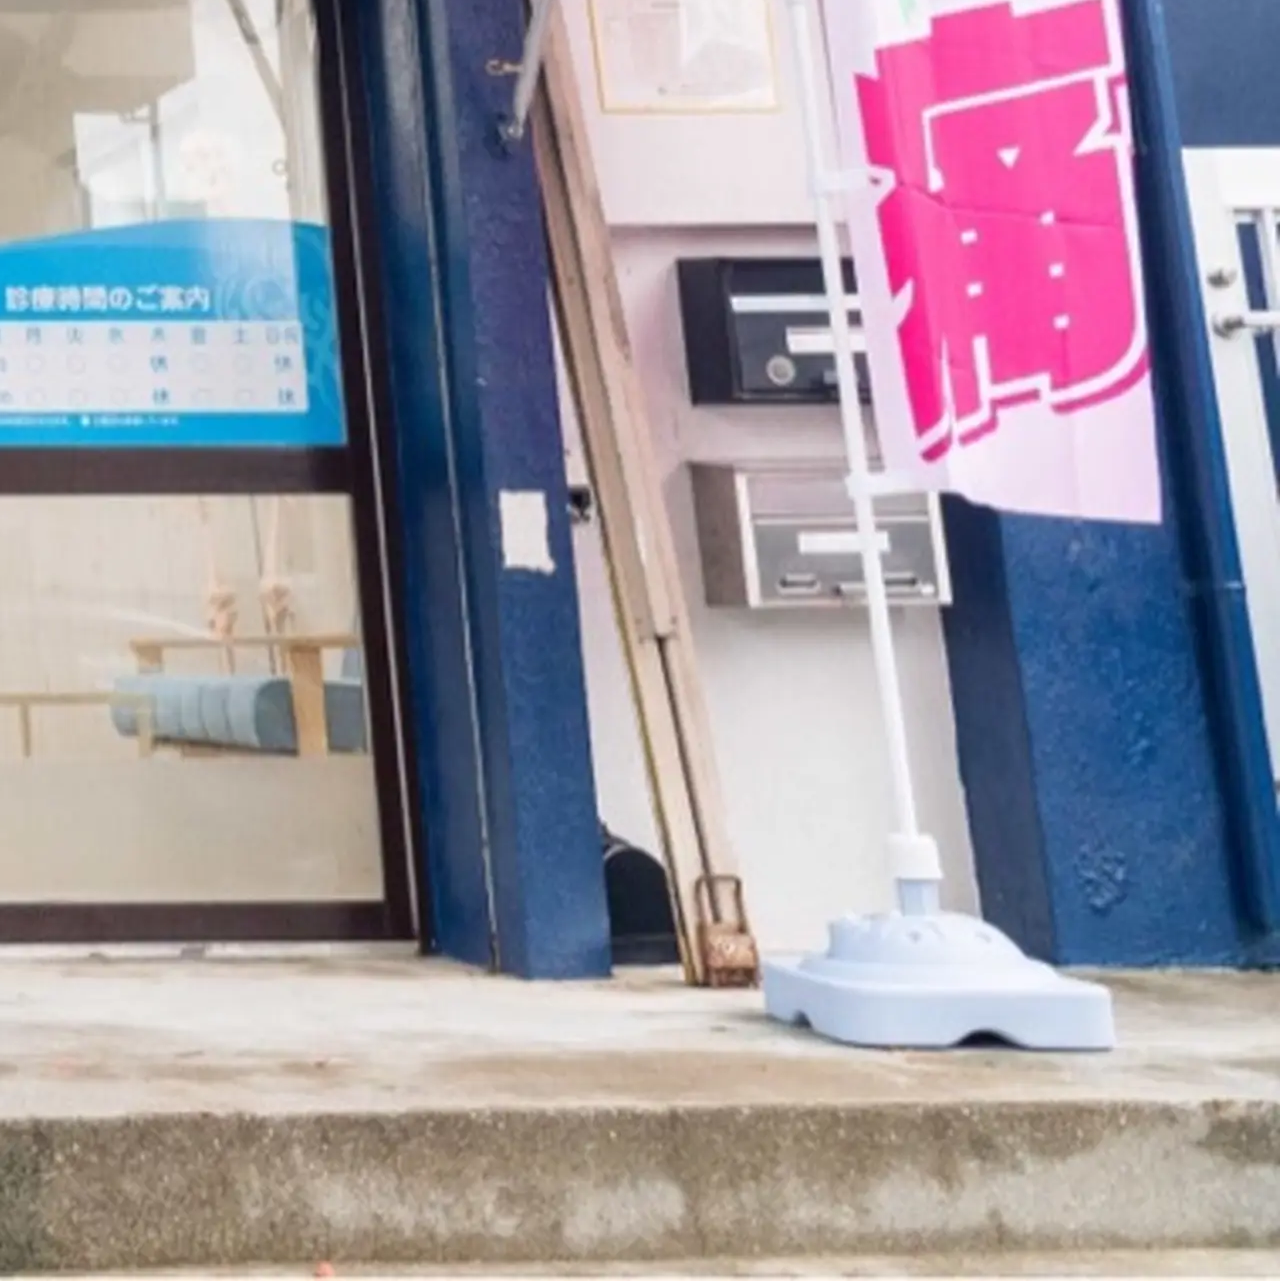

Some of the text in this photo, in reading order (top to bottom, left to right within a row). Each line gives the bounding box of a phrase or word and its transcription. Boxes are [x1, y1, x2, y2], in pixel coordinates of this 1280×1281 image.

[4, 284, 211, 313] 診療時間のご案内
